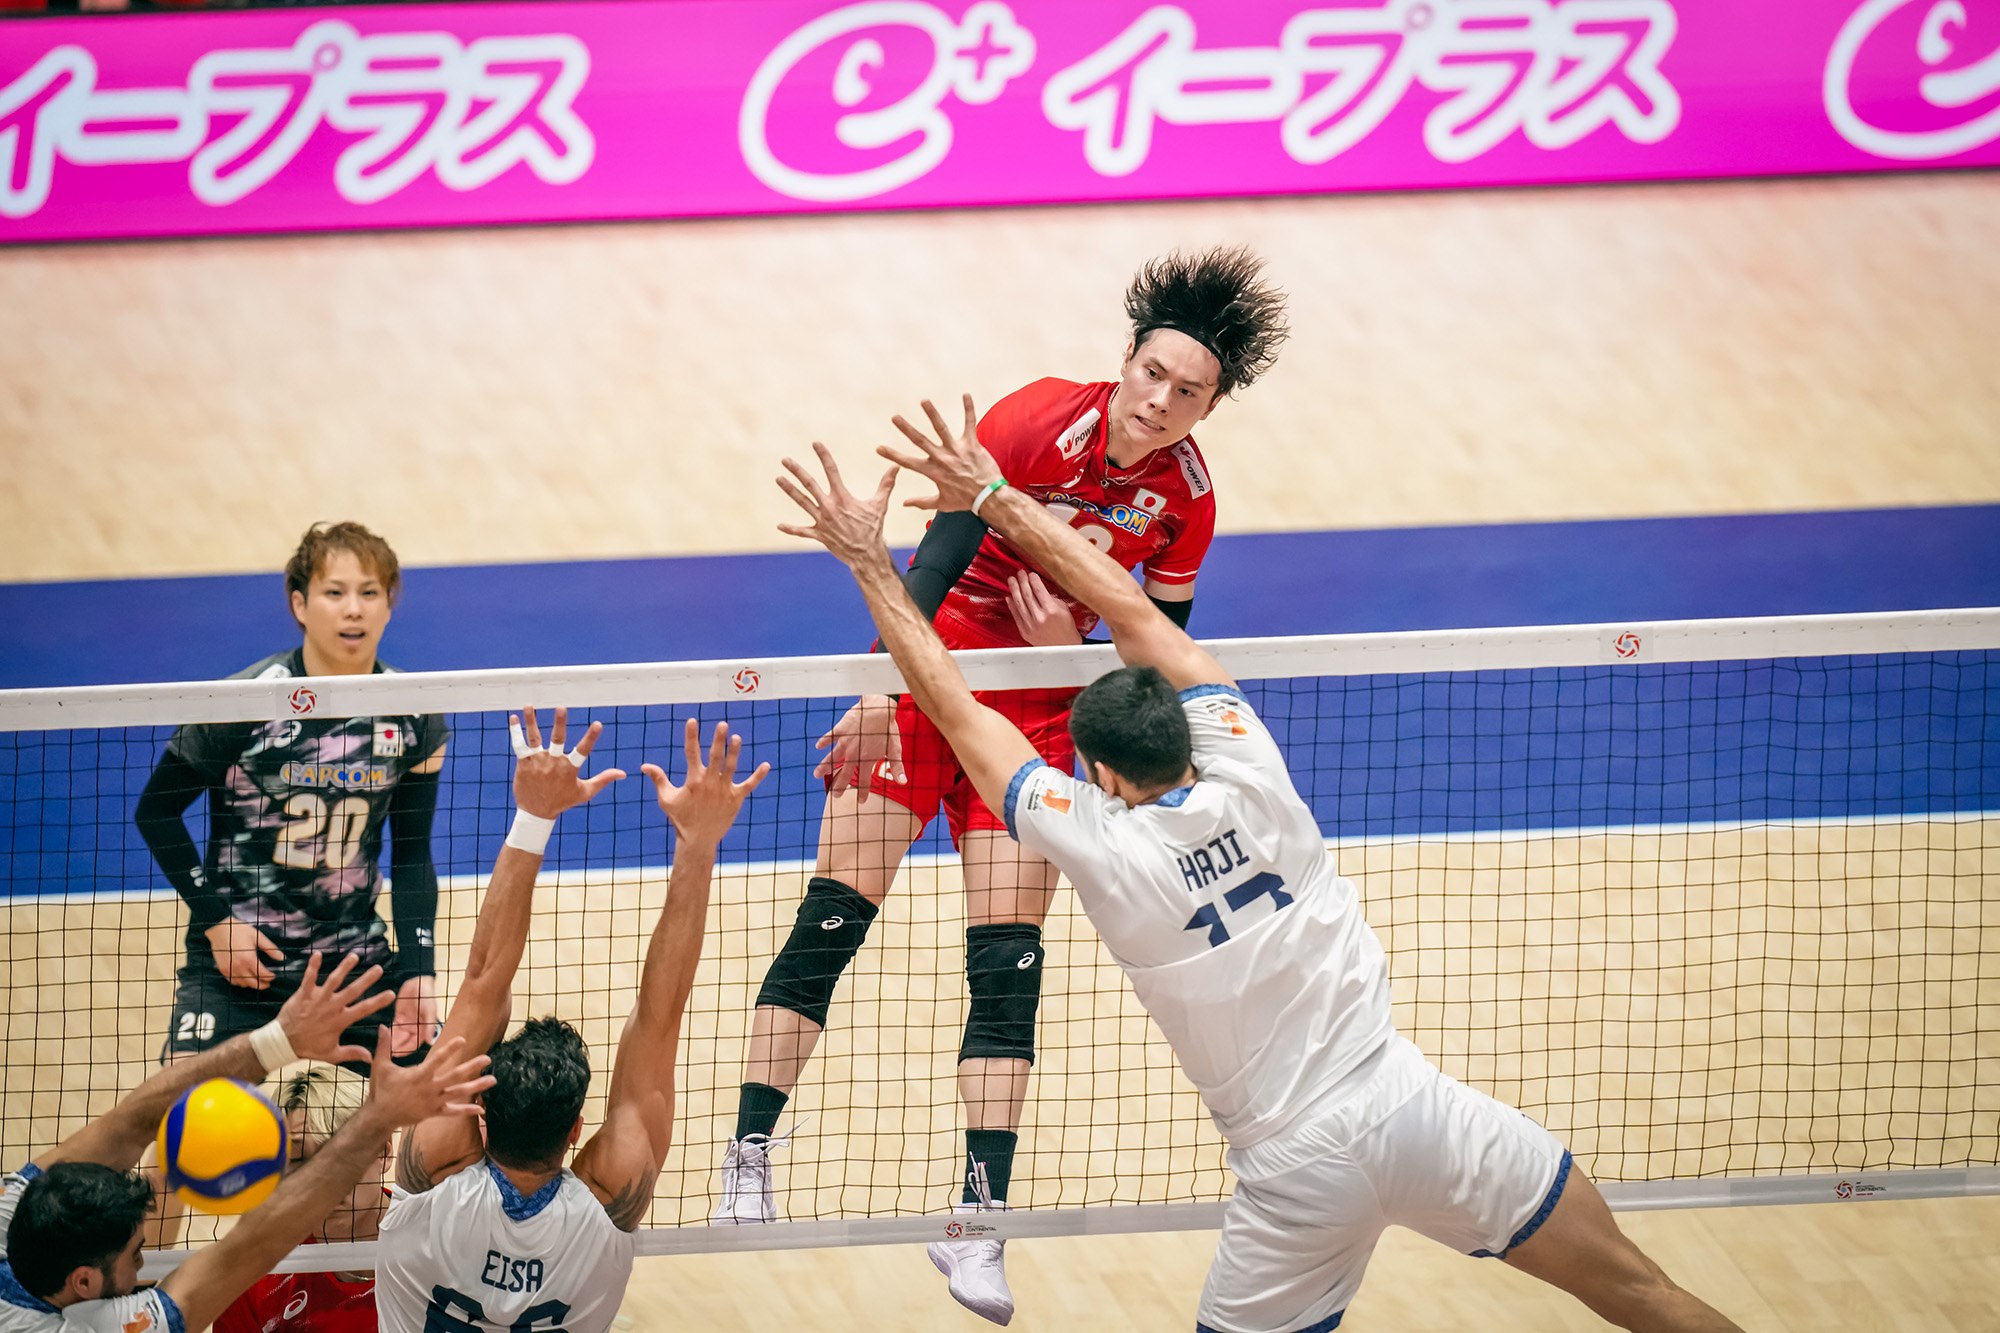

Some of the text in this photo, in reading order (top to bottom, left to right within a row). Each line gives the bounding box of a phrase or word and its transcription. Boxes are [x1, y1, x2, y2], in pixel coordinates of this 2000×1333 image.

[1041, 0, 1683, 177] イープラス
[0, 20, 596, 218] イープラス
[1185, 460, 1205, 492] POWER
[280, 761, 388, 788] CAPCOM
[272, 792, 371, 870] 20
[1177, 828, 1250, 892] HAJI
[177, 1011, 216, 1041] 20
[481, 1249, 544, 1293] EISA
